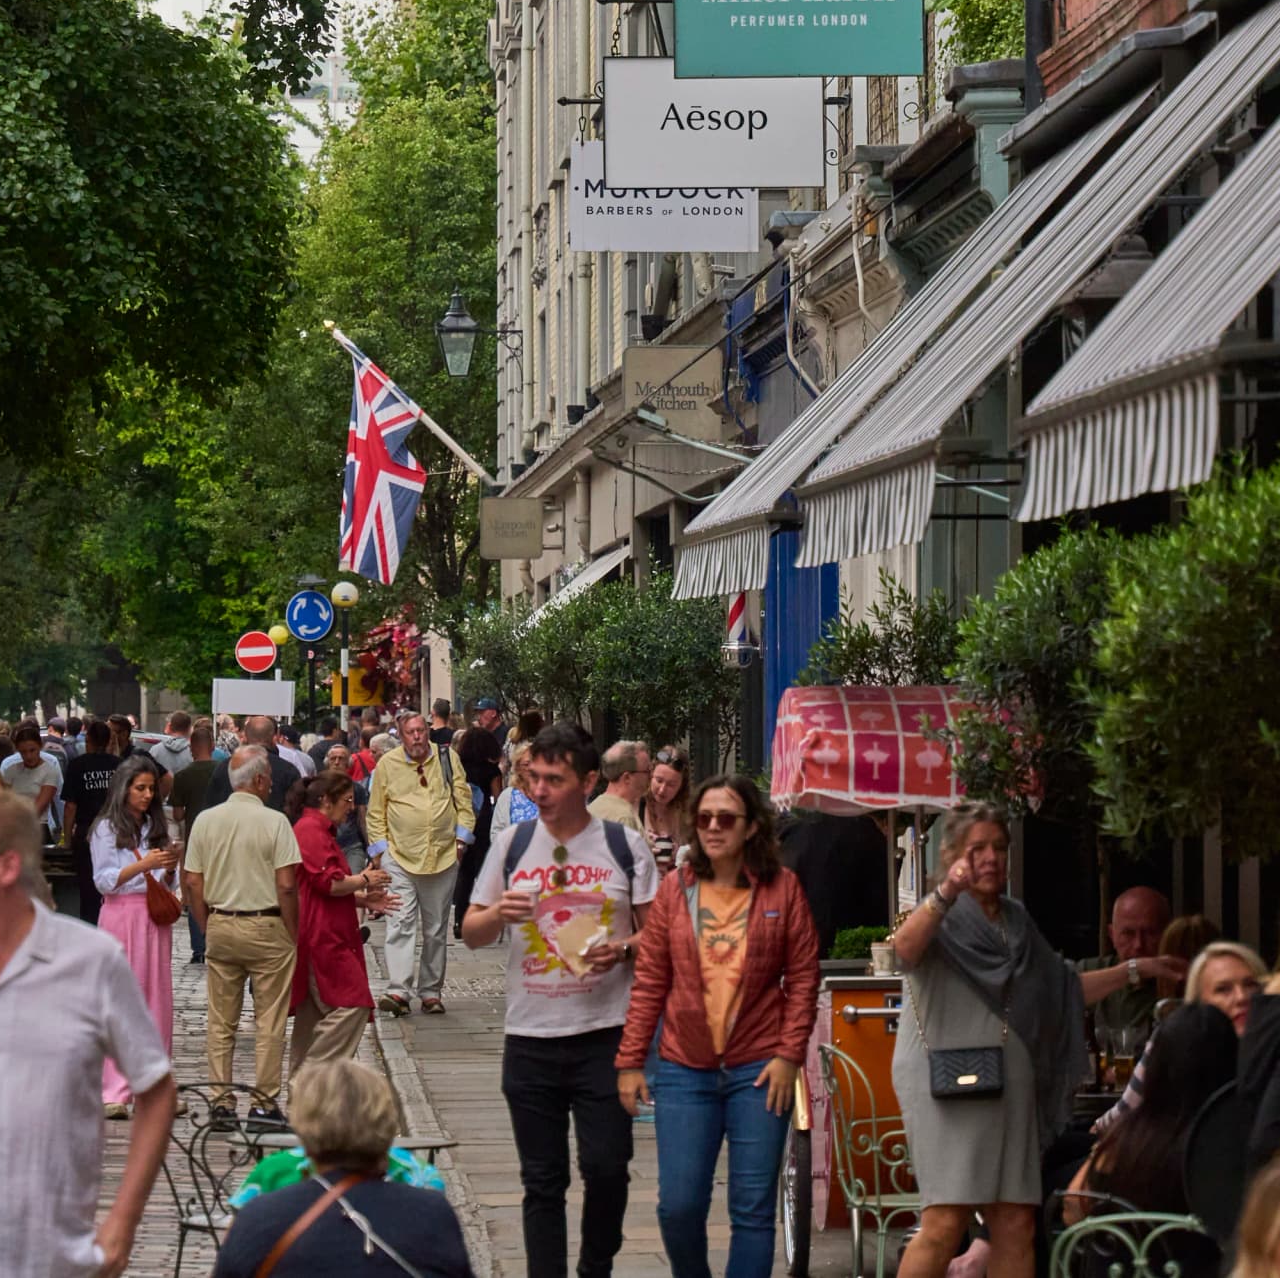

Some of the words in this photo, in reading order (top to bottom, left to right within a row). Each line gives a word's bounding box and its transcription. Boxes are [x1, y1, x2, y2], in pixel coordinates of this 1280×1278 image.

[730, 14, 806, 27] PERFUMER
[812, 13, 868, 27] LONDON
[659, 102, 768, 140] Aēsop
[586, 206, 653, 216] BARBERS
[682, 206, 744, 216] LONDON
[634, 381, 710, 397] Monmouth
